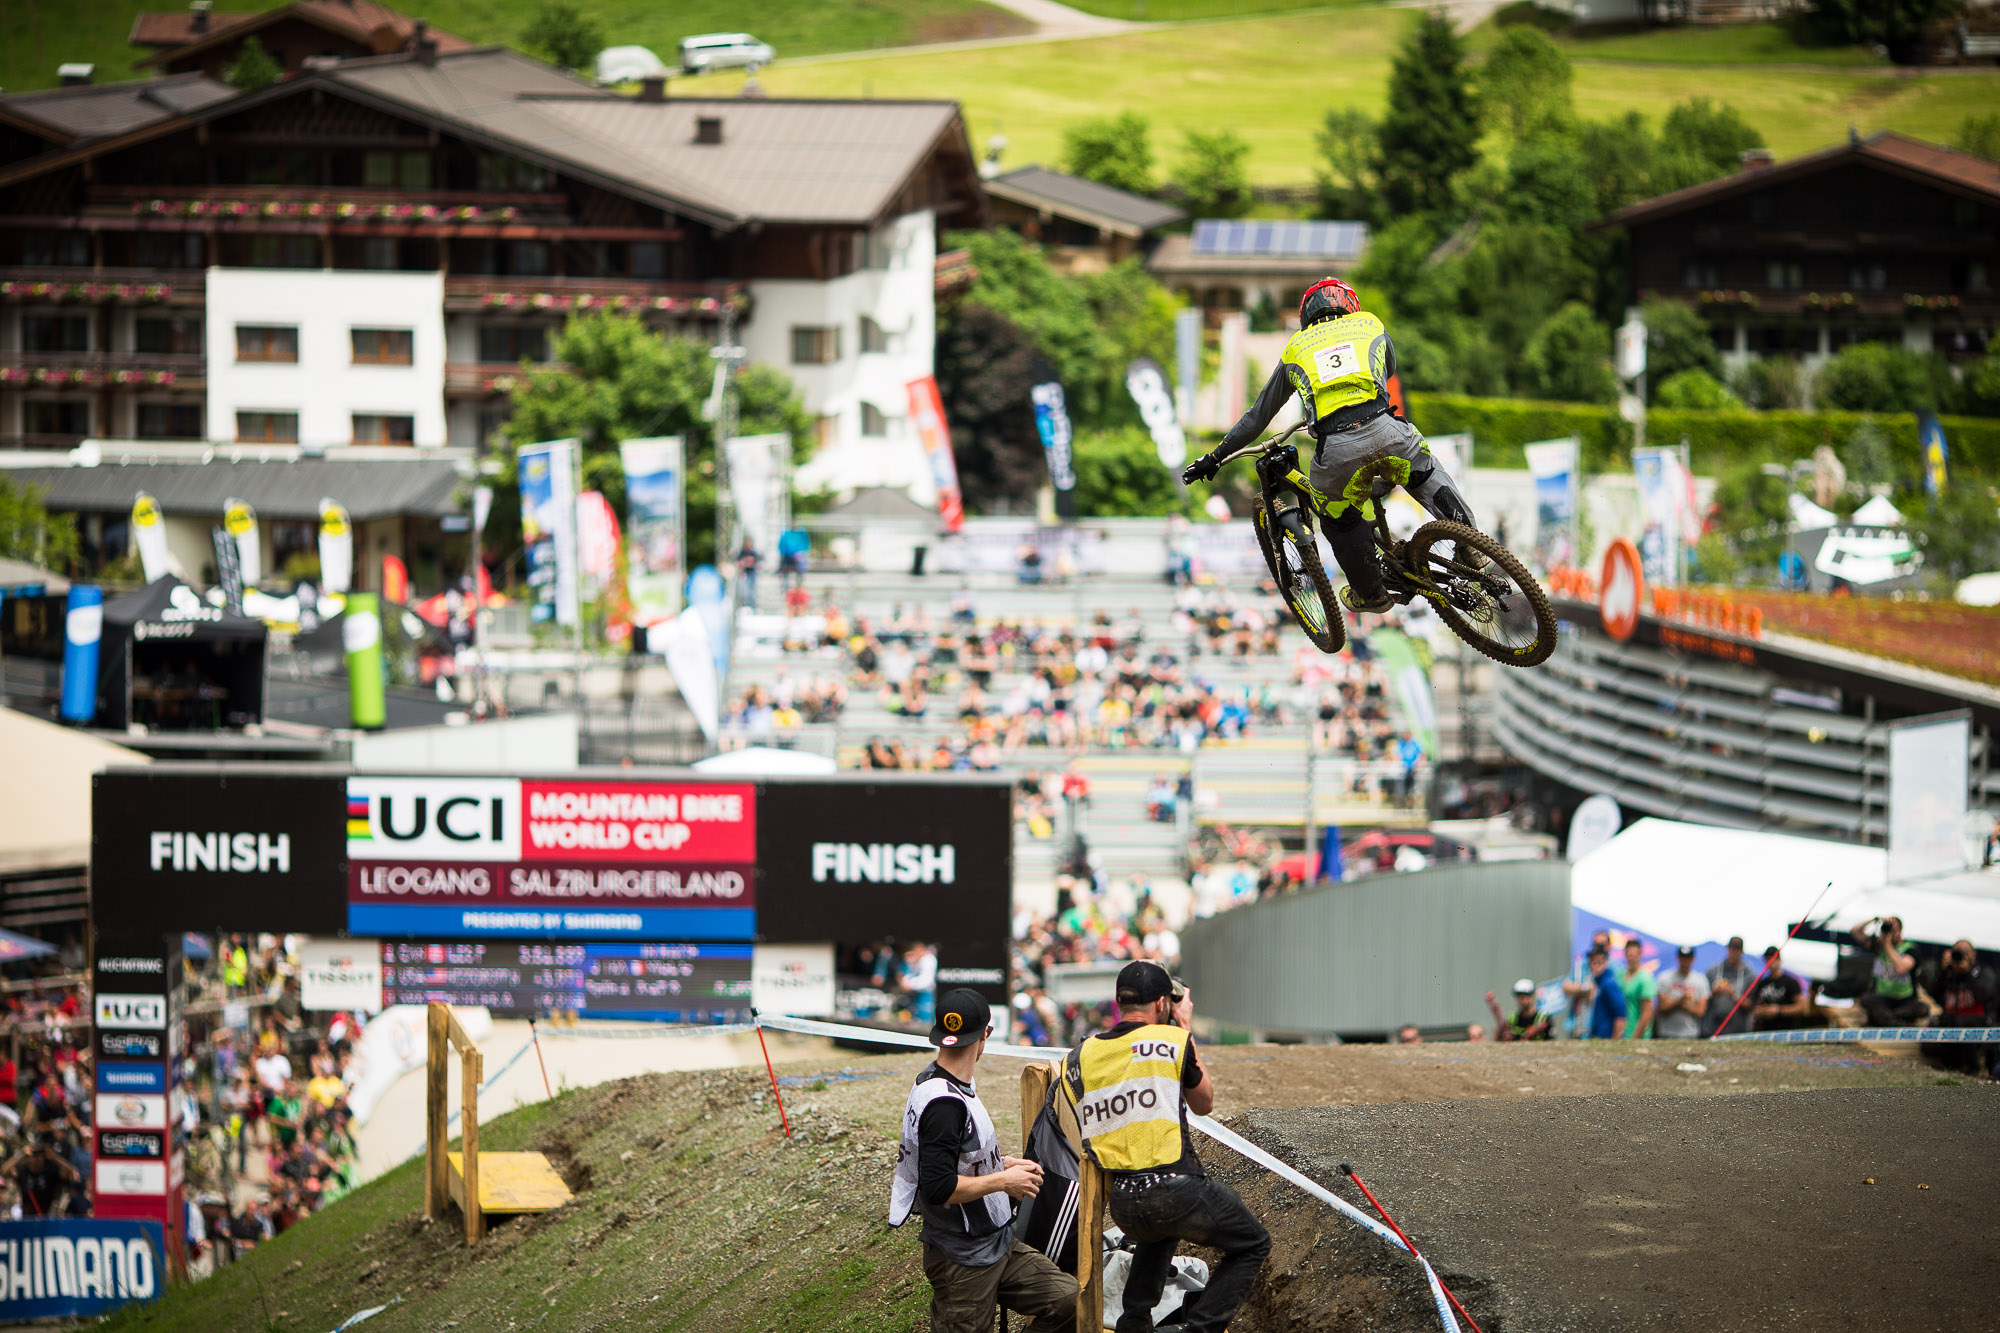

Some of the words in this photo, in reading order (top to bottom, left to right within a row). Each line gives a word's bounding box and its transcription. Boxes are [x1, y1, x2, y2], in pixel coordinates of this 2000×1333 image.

[1329, 354, 1342, 369] 3
[379, 796, 504, 841] UCI
[529, 793, 679, 821] MOUNTAIN
[681, 795, 744, 822] BIKE
[529, 822, 631, 849] WORLD
[632, 823, 692, 850] CUP
[151, 831, 291, 873] FINISH
[812, 842, 956, 884] FINISH
[360, 866, 491, 896] LEOGANG
[509, 868, 745, 898] SALZBURGERLAND
[114, 1003, 159, 1020] UCI
[1139, 1043, 1175, 1059] UCI
[1082, 1088, 1157, 1126] PHOTO
